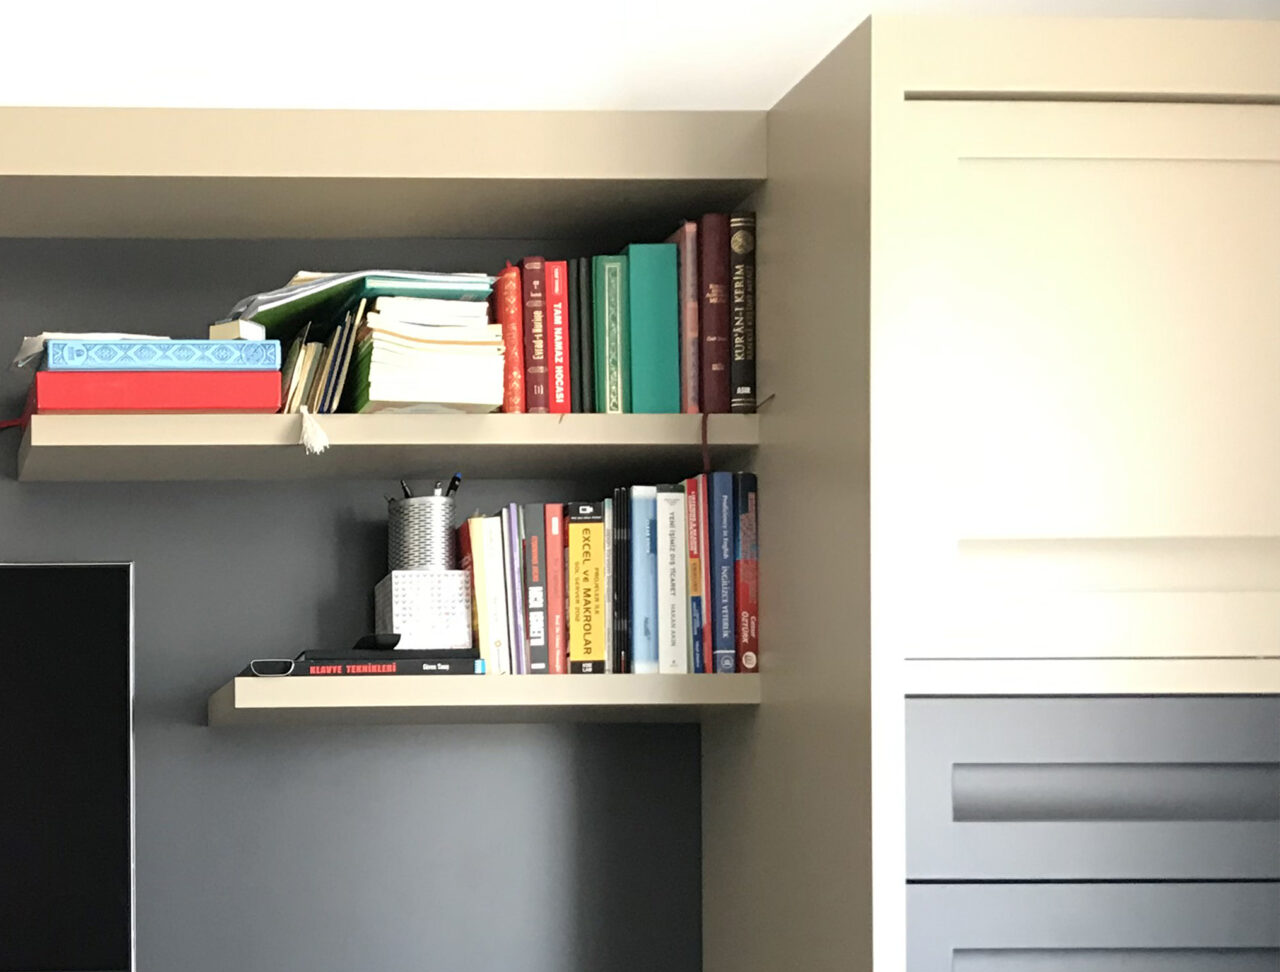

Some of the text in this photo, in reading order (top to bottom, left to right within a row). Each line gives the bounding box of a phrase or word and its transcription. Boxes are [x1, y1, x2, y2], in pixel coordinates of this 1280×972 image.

[553, 302, 562, 325] TAM
[554, 327, 563, 364] NAMAZ
[555, 366, 564, 403] HOCASI
[582, 527, 593, 655] EXCEL ve MAKROLAR
